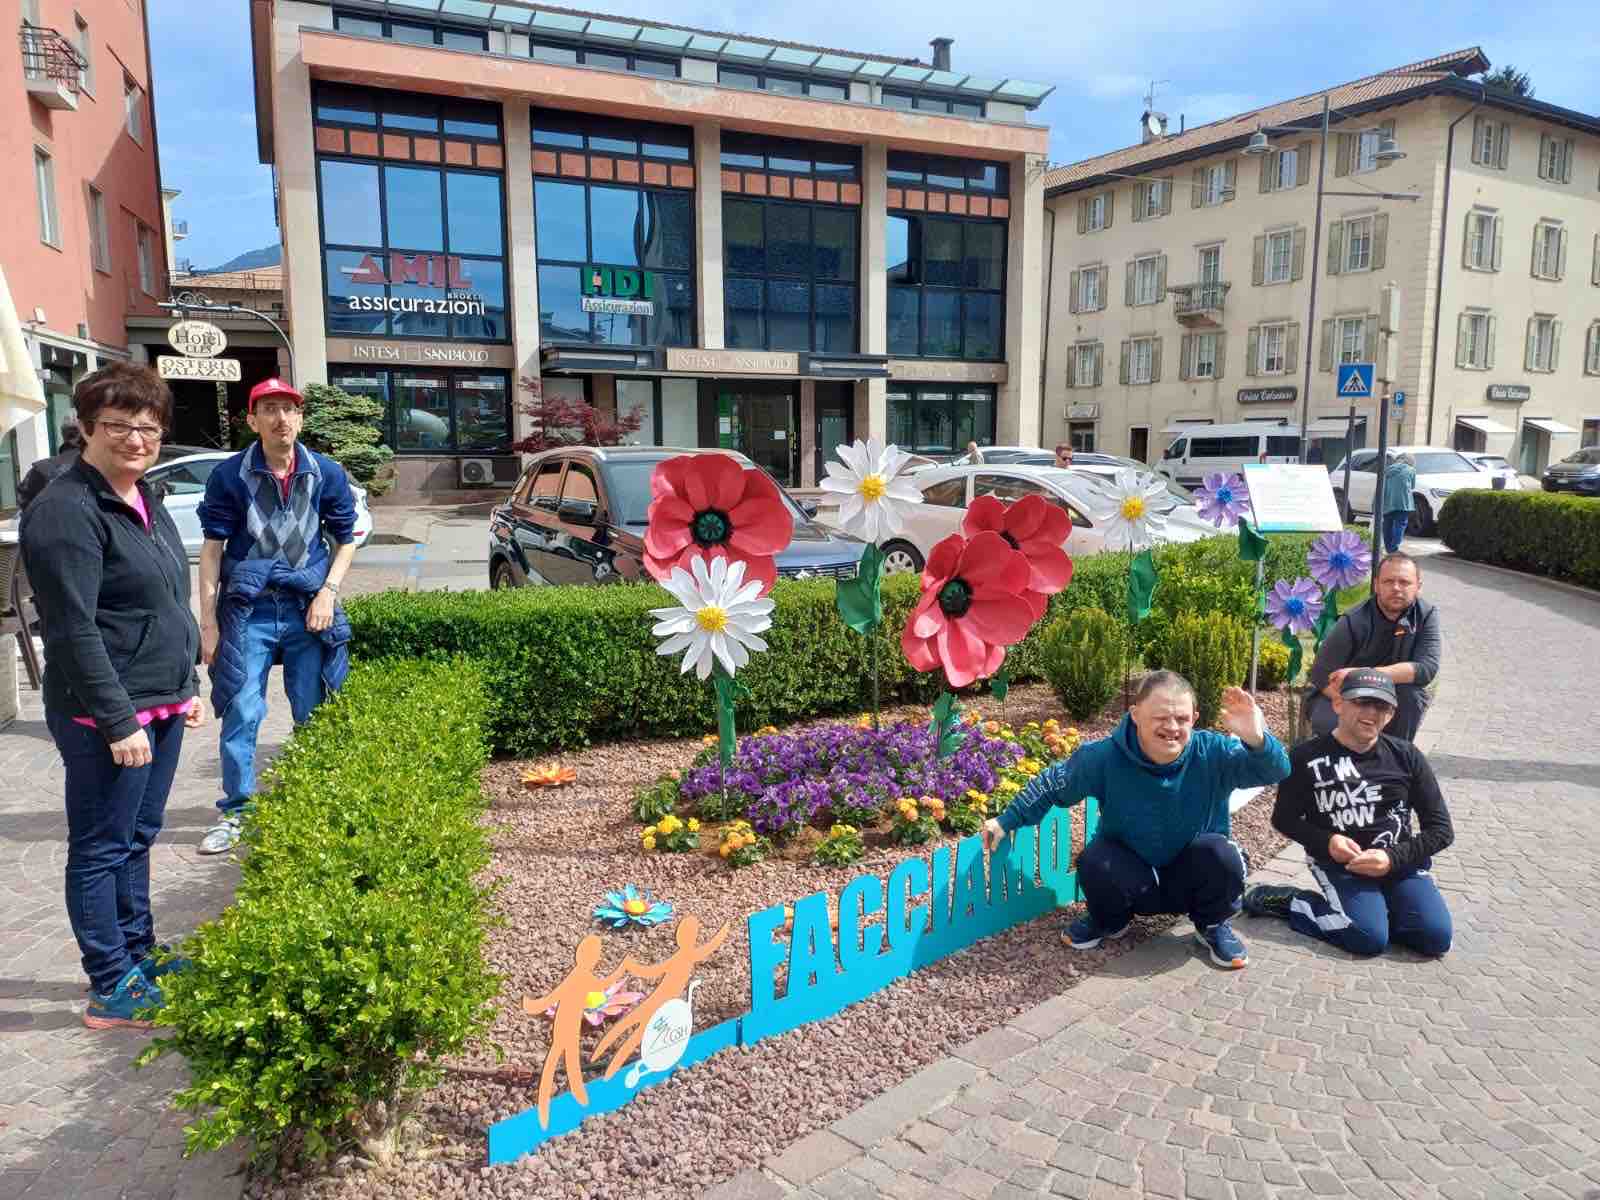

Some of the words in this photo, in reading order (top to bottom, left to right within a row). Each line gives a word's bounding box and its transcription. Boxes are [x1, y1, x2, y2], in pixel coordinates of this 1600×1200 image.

[344, 252, 472, 289] AMIL
[583, 265, 655, 298] HDI
[348, 294, 486, 316] assicurazioni
[174, 328, 222, 347] Hotel
[161, 358, 237, 370] OSTERIA
[352, 344, 401, 360] INTESA
[423, 345, 489, 362] SANPAOLO
[1307, 755, 1361, 788] I'M
[1313, 780, 1383, 813] WOKE
[1329, 804, 1376, 831] NOW
[747, 804, 1070, 1003] FACCIAMO
